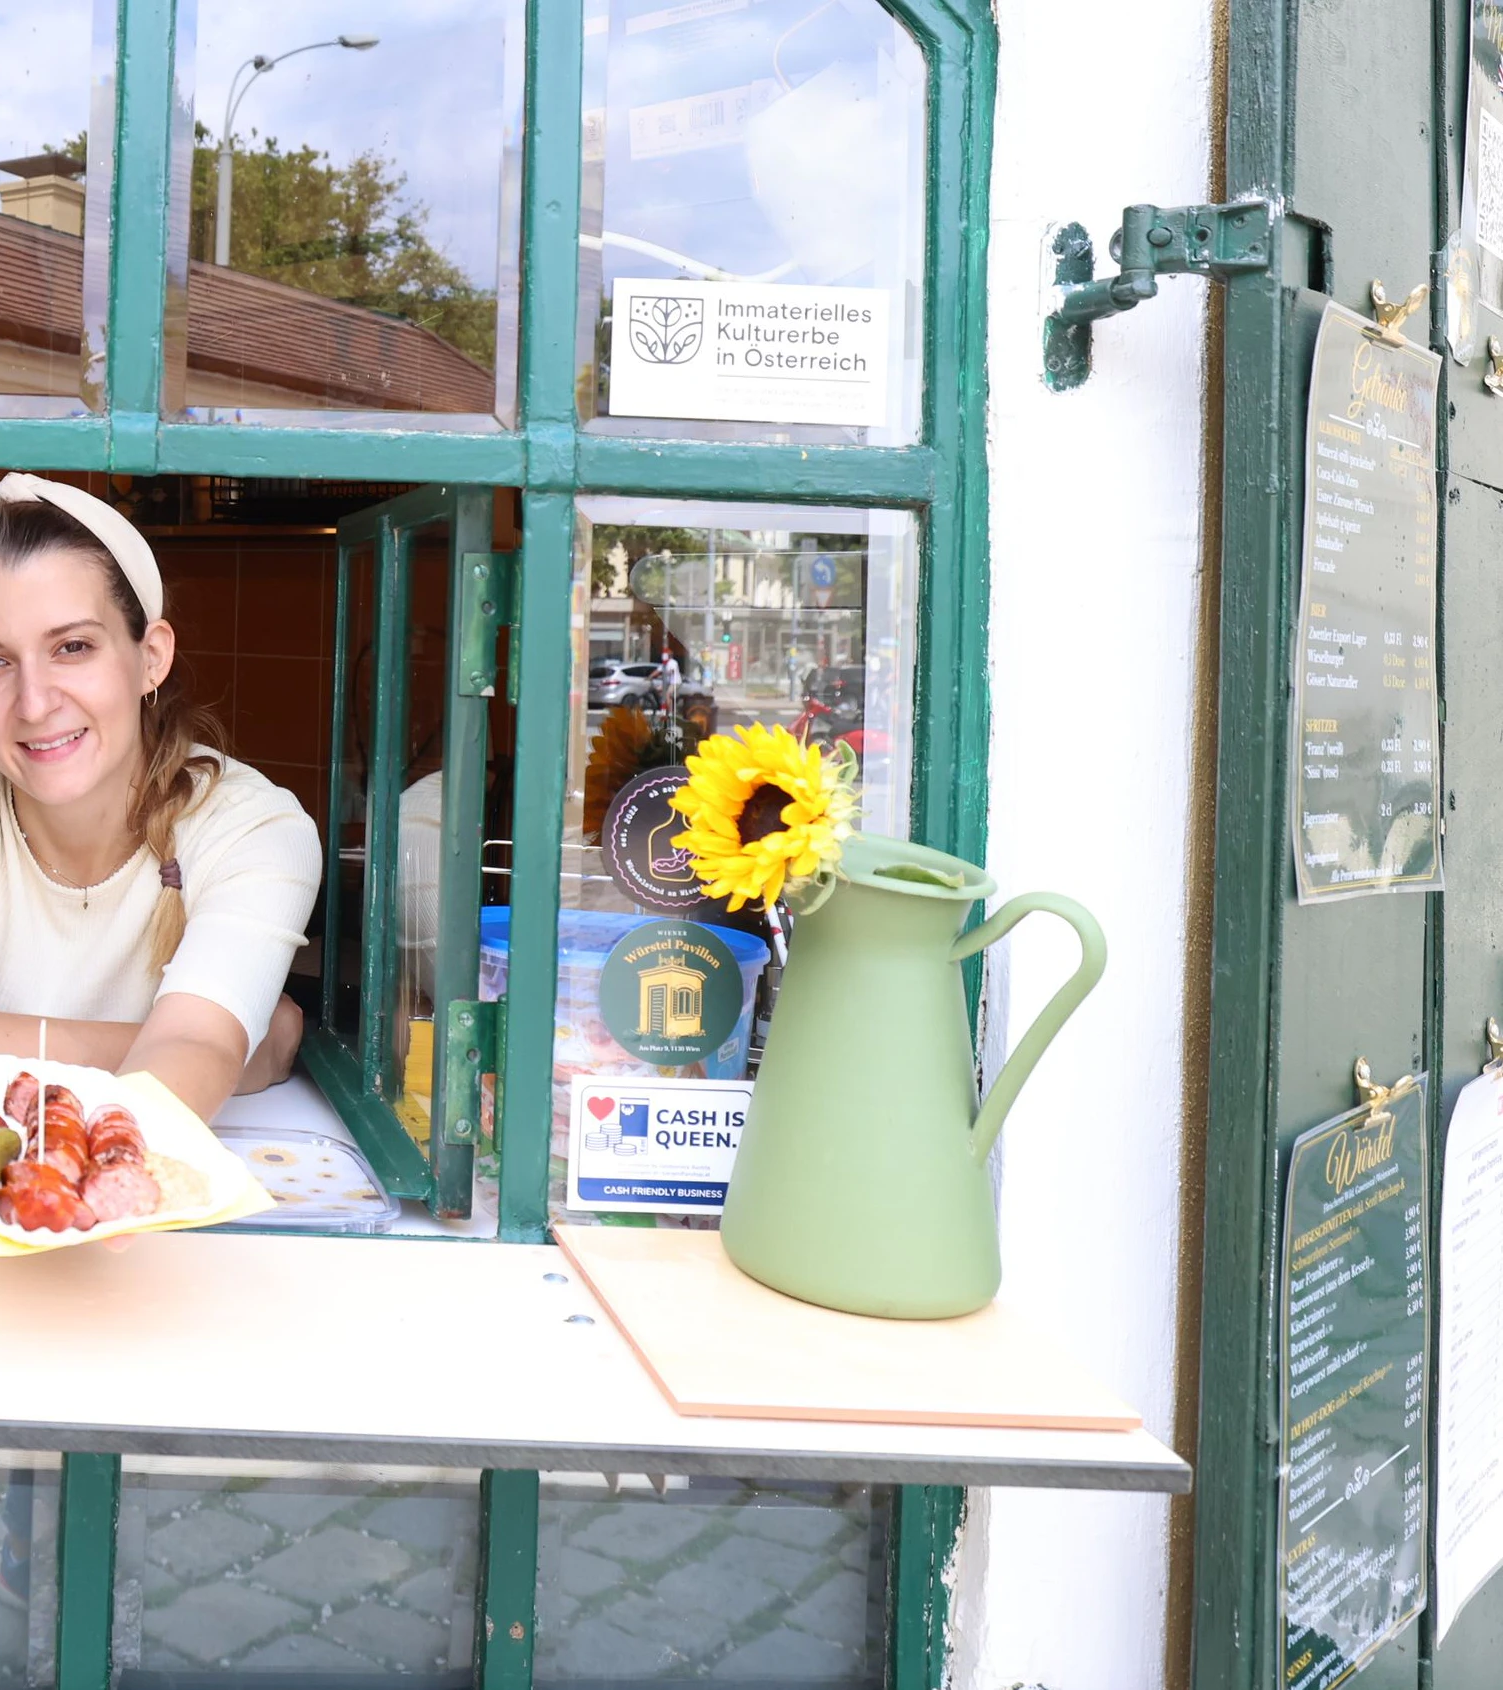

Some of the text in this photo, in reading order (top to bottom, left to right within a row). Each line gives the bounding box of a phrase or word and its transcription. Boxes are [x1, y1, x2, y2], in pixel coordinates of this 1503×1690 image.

[718, 299, 872, 323] Immaterielles
[717, 322, 839, 345] Kulturerbe
[717, 344, 867, 371] in Österreich
[623, 939, 721, 969] Würstel Pavillon
[656, 1109, 745, 1127] CASH IS
[655, 1130, 737, 1150] QUEEN.
[1325, 1115, 1396, 1194] Würstel
[604, 1186, 723, 1198] CASH FRIENDLY BUSINESS
